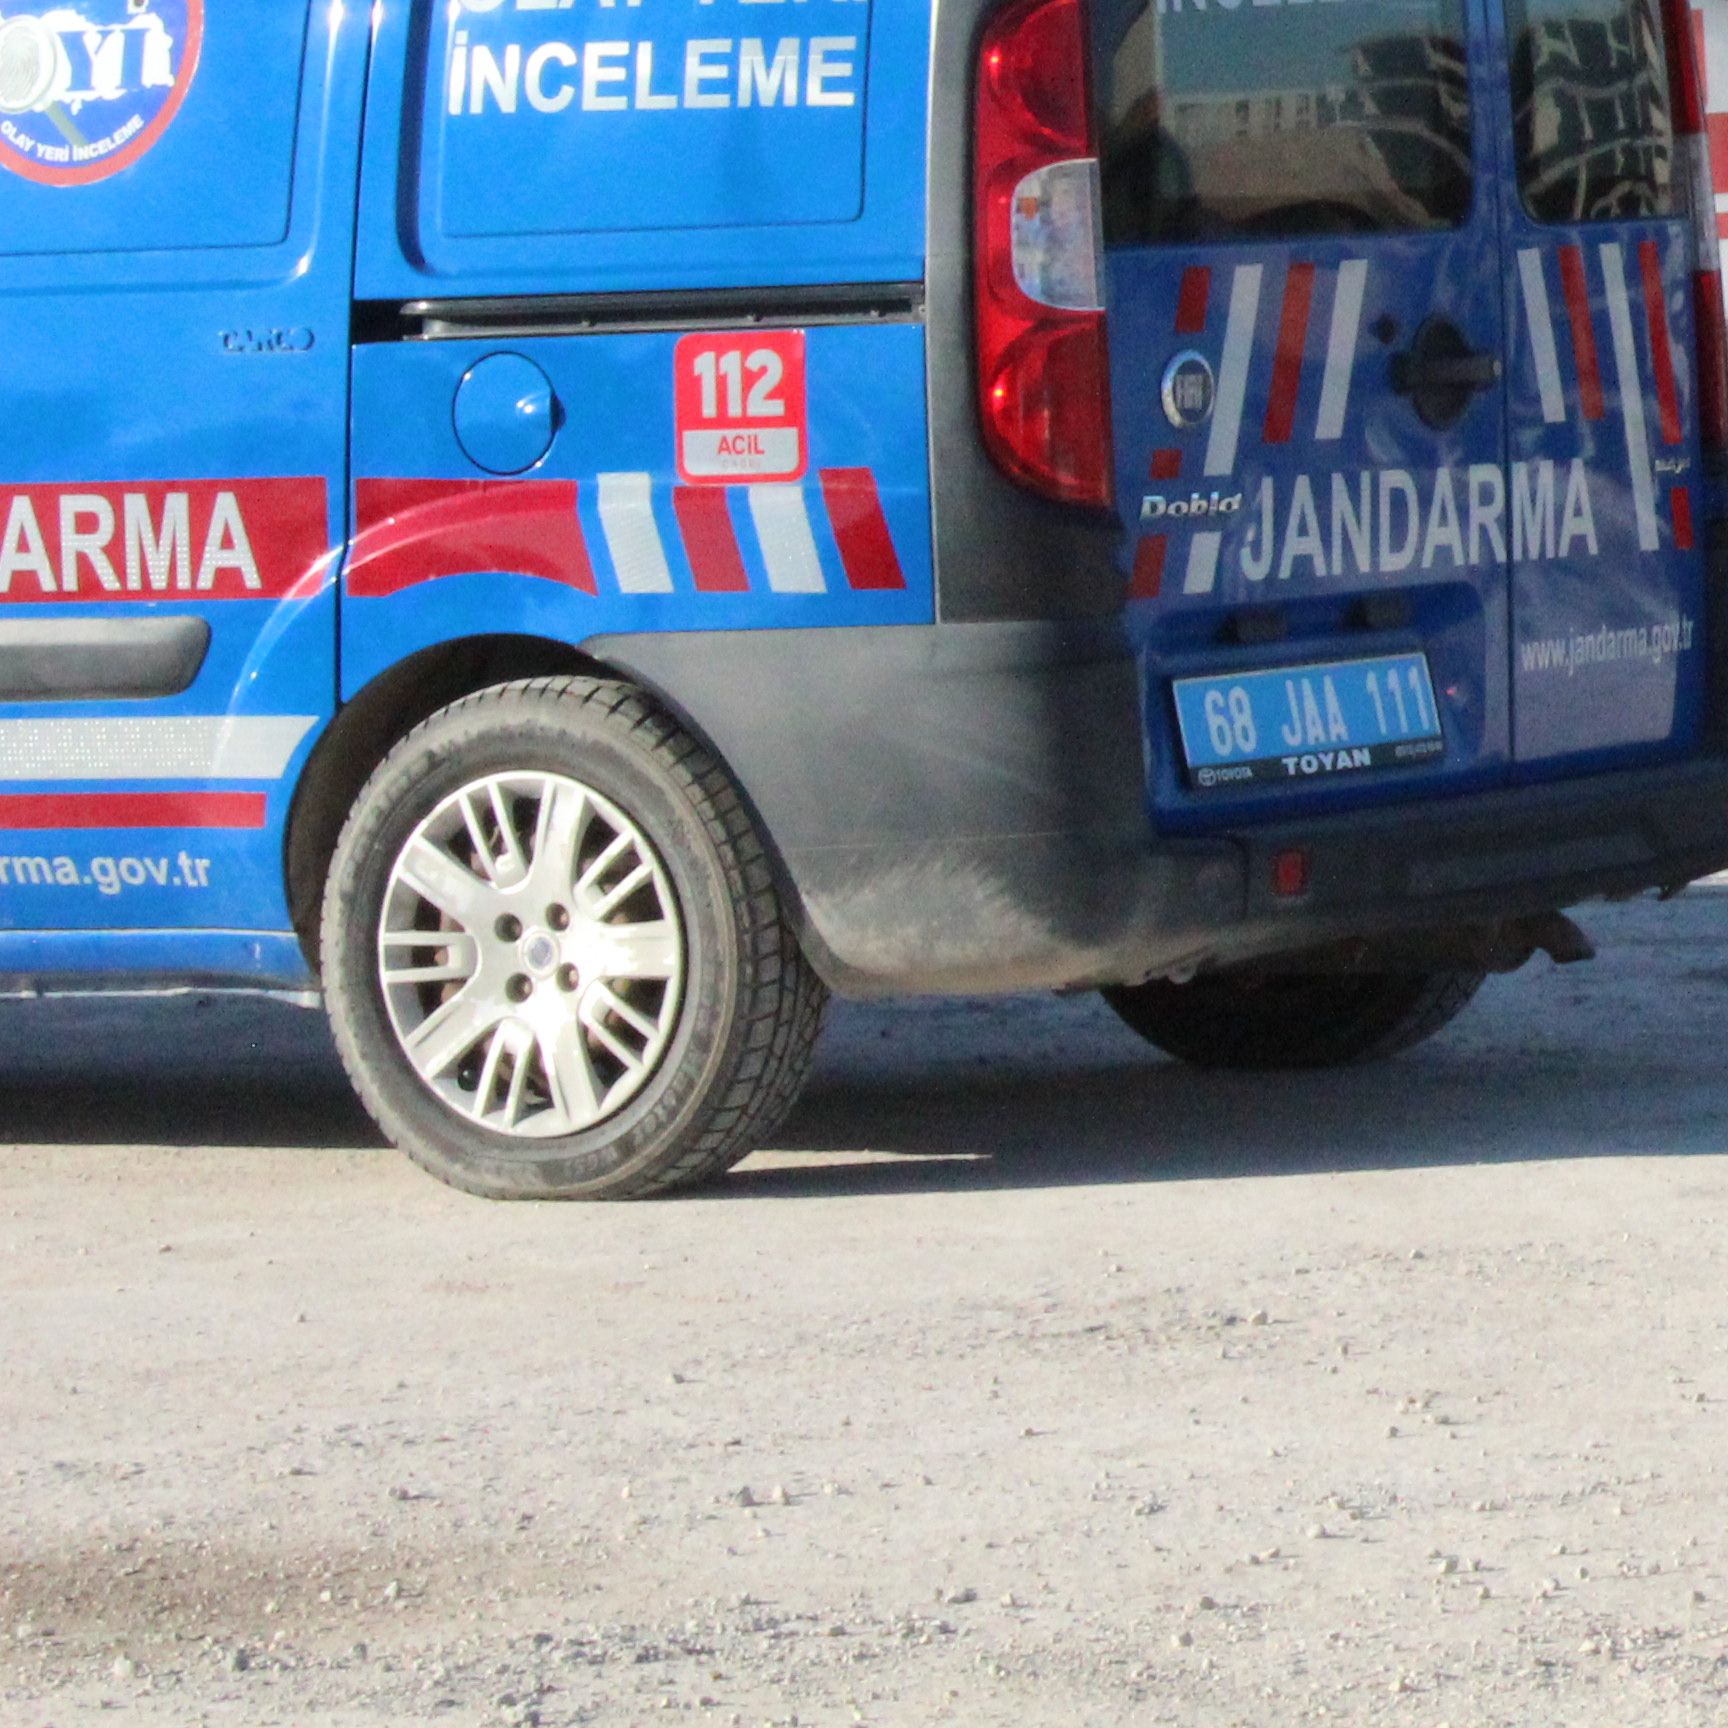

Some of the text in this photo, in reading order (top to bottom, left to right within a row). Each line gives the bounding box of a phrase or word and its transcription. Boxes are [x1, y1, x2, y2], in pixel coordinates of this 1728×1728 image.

[447, 29, 857, 116] İNCELEME
[1, 120, 35, 152] OLAY
[72, 114, 145, 162] İNCELEME
[692, 348, 786, 419] 112
[1240, 458, 1600, 582] JANDARMA
[1521, 613, 1695, 677] www.jandarma.gov.tr
[1204, 665, 1430, 757] 68 JAA 111
[1282, 747, 1371, 776] TOYAN
